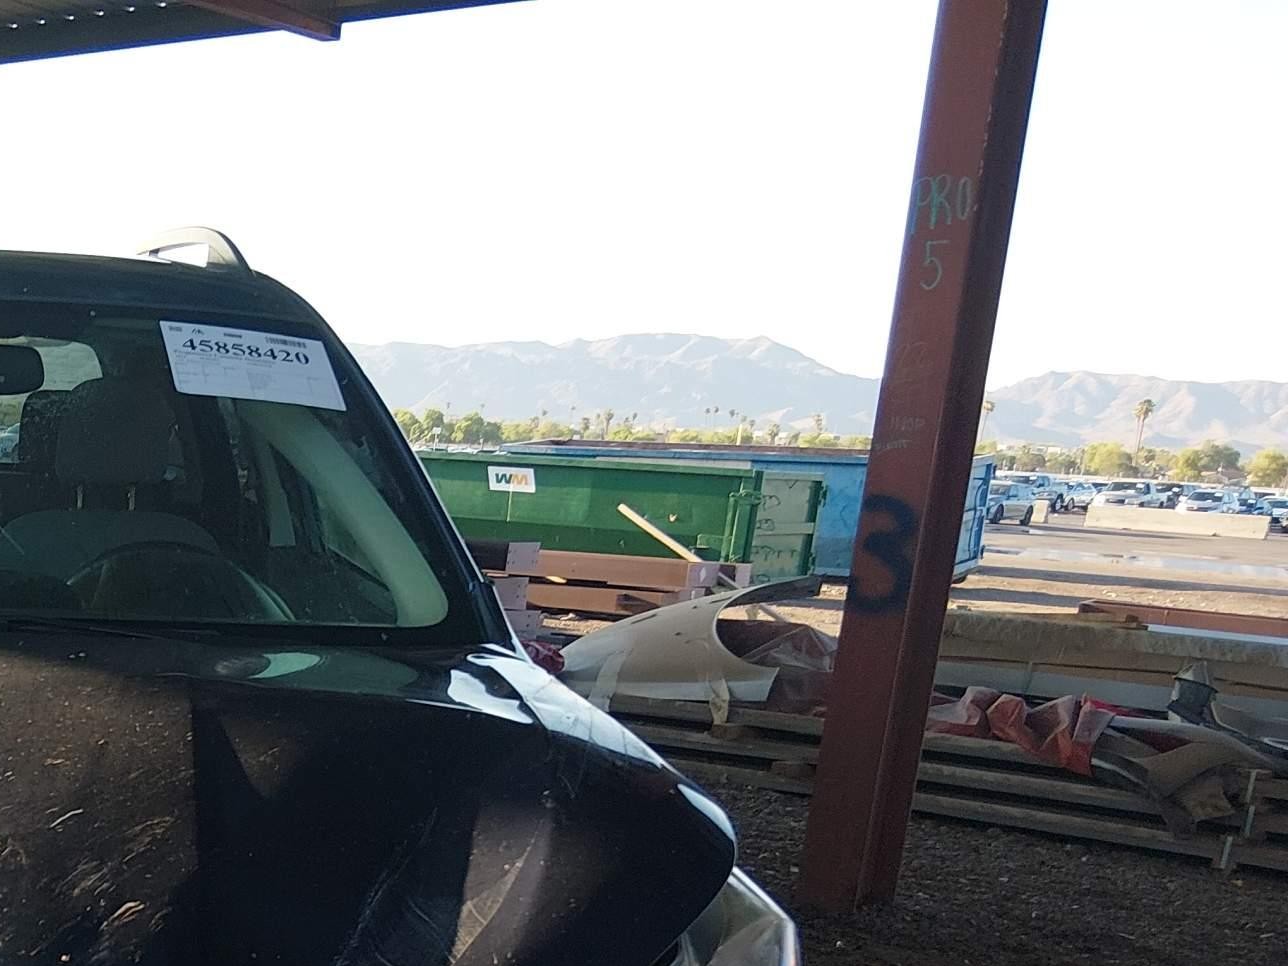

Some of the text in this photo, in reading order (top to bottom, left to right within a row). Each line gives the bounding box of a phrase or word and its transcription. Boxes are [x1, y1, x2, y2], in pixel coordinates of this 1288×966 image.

[919, 239, 950, 290] 5
[181, 337, 310, 366] 45858420
[495, 472, 529, 486] WM
[850, 494, 920, 614] 3
